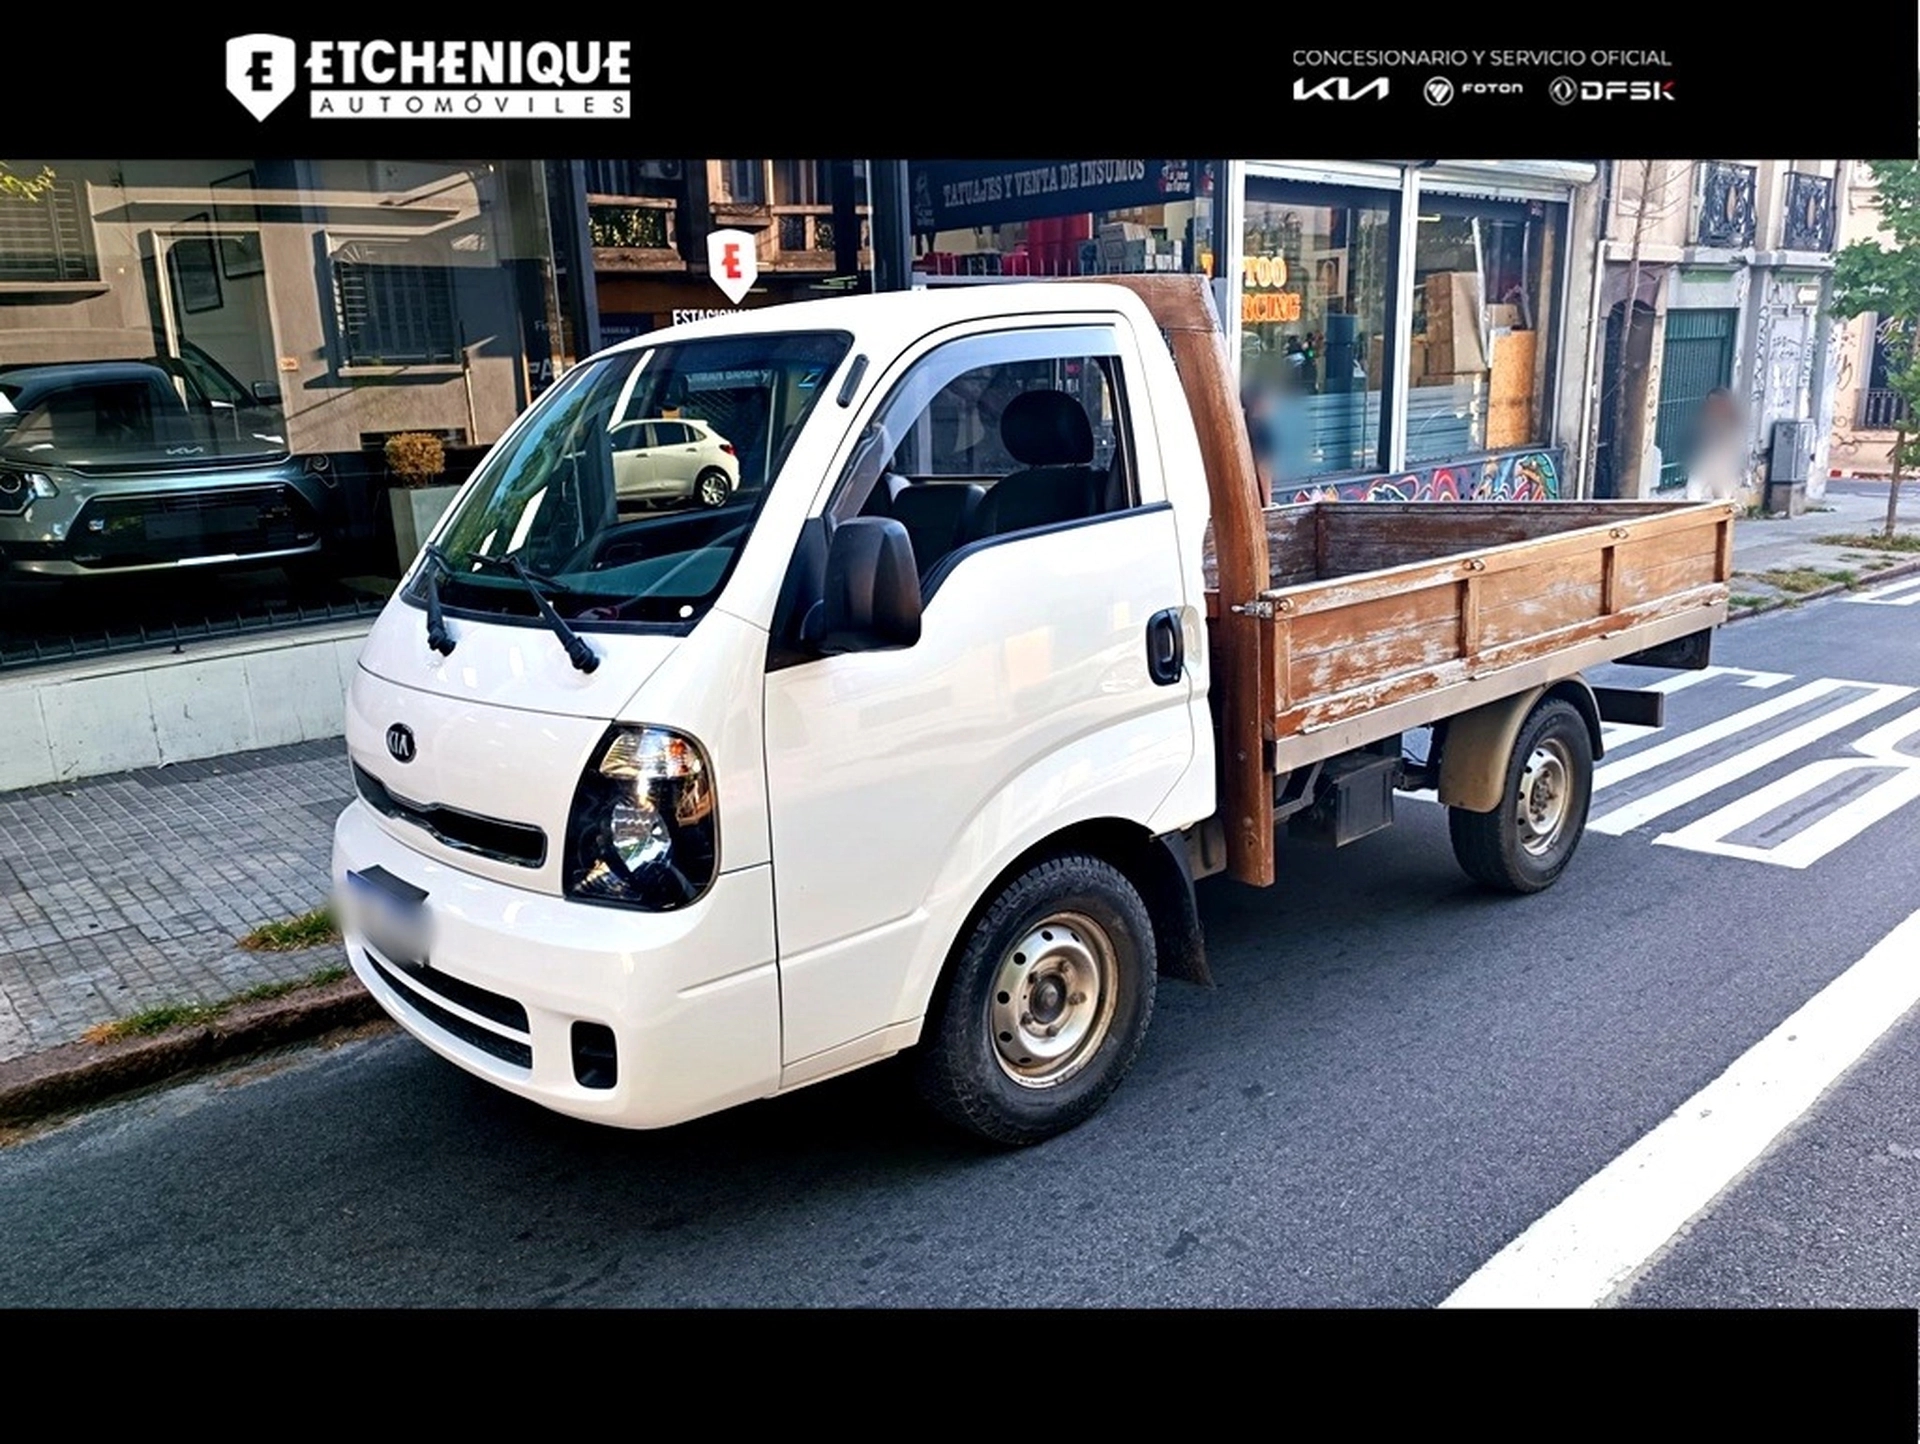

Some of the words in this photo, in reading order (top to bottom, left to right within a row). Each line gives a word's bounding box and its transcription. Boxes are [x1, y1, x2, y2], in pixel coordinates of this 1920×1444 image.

[943, 176, 1003, 207] TATUAJES
[1003, 173, 1013, 198] Y
[1014, 166, 1059, 197] VENTA
[1060, 162, 1079, 190] DE
[1080, 159, 1146, 187] INSUMOS
[389, 730, 410, 757] KIA
